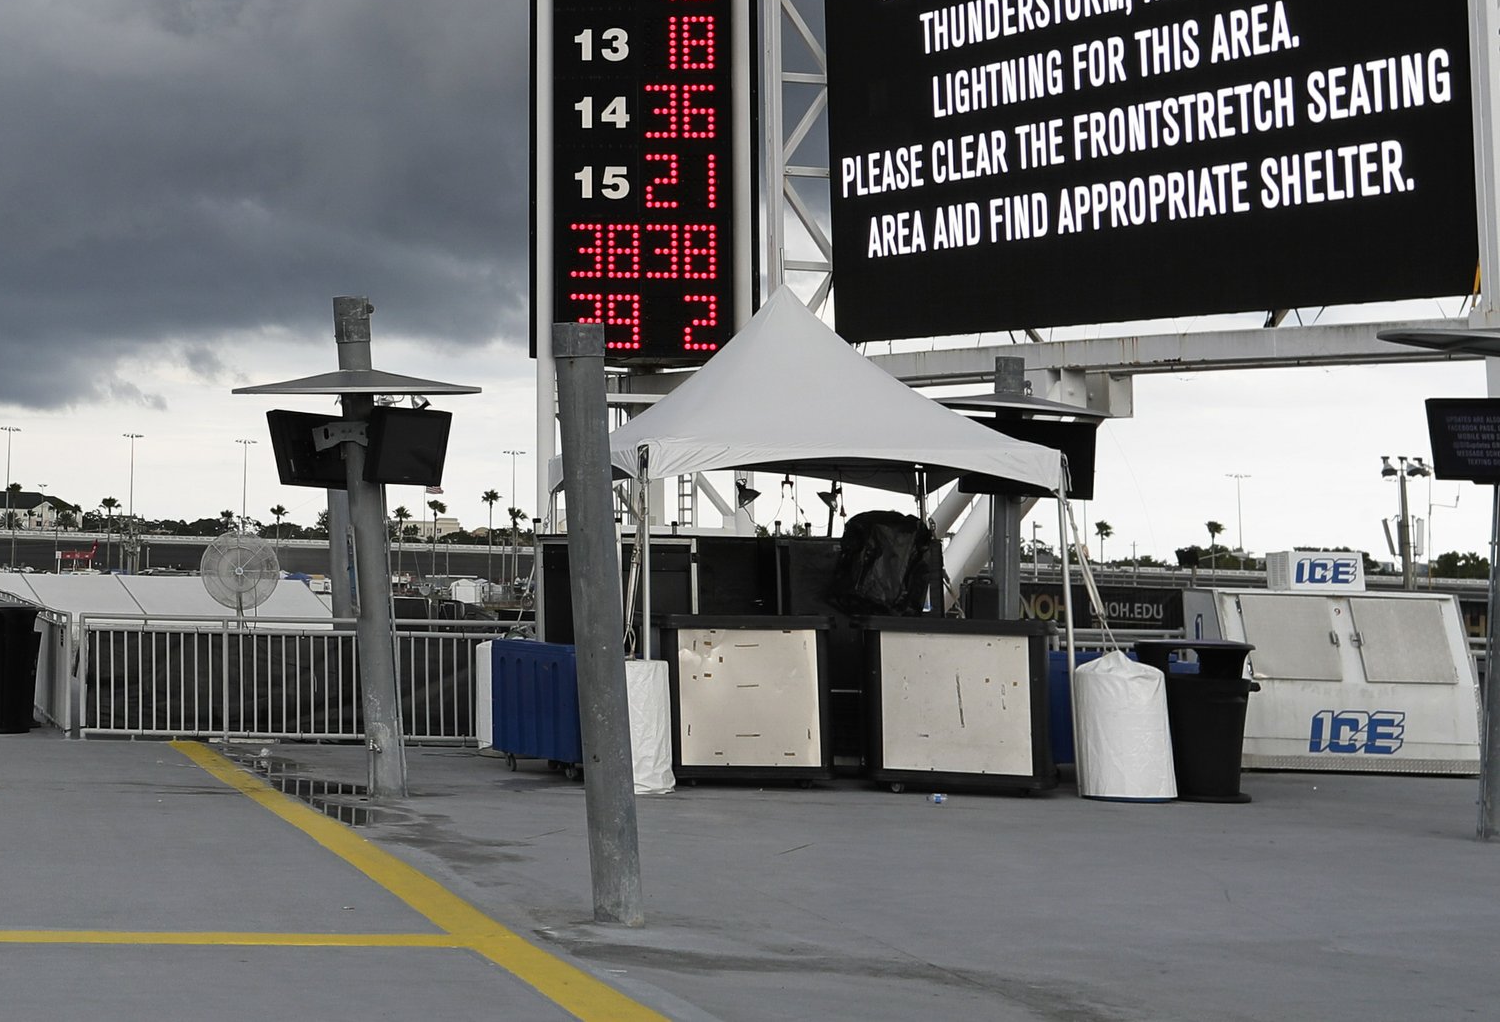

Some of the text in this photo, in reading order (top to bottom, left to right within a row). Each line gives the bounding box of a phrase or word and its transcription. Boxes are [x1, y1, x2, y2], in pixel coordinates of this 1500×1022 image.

[574, 16, 715, 69] 13 18
[933, 1, 1299, 118] LIGHTNING FOR THIS AREA.
[574, 84, 715, 138] 14 36
[842, 49, 1451, 198] PLEASE CLEAR THE FRONTSTRETCH SEATING
[574, 154, 716, 208] 15 21
[868, 140, 1414, 258] AREA AND FIND APPROPRIATE SHELTER.
[684, 295, 717, 350] 2
[1295, 558, 1357, 584] ICE
[1309, 710, 1405, 754] ICE
